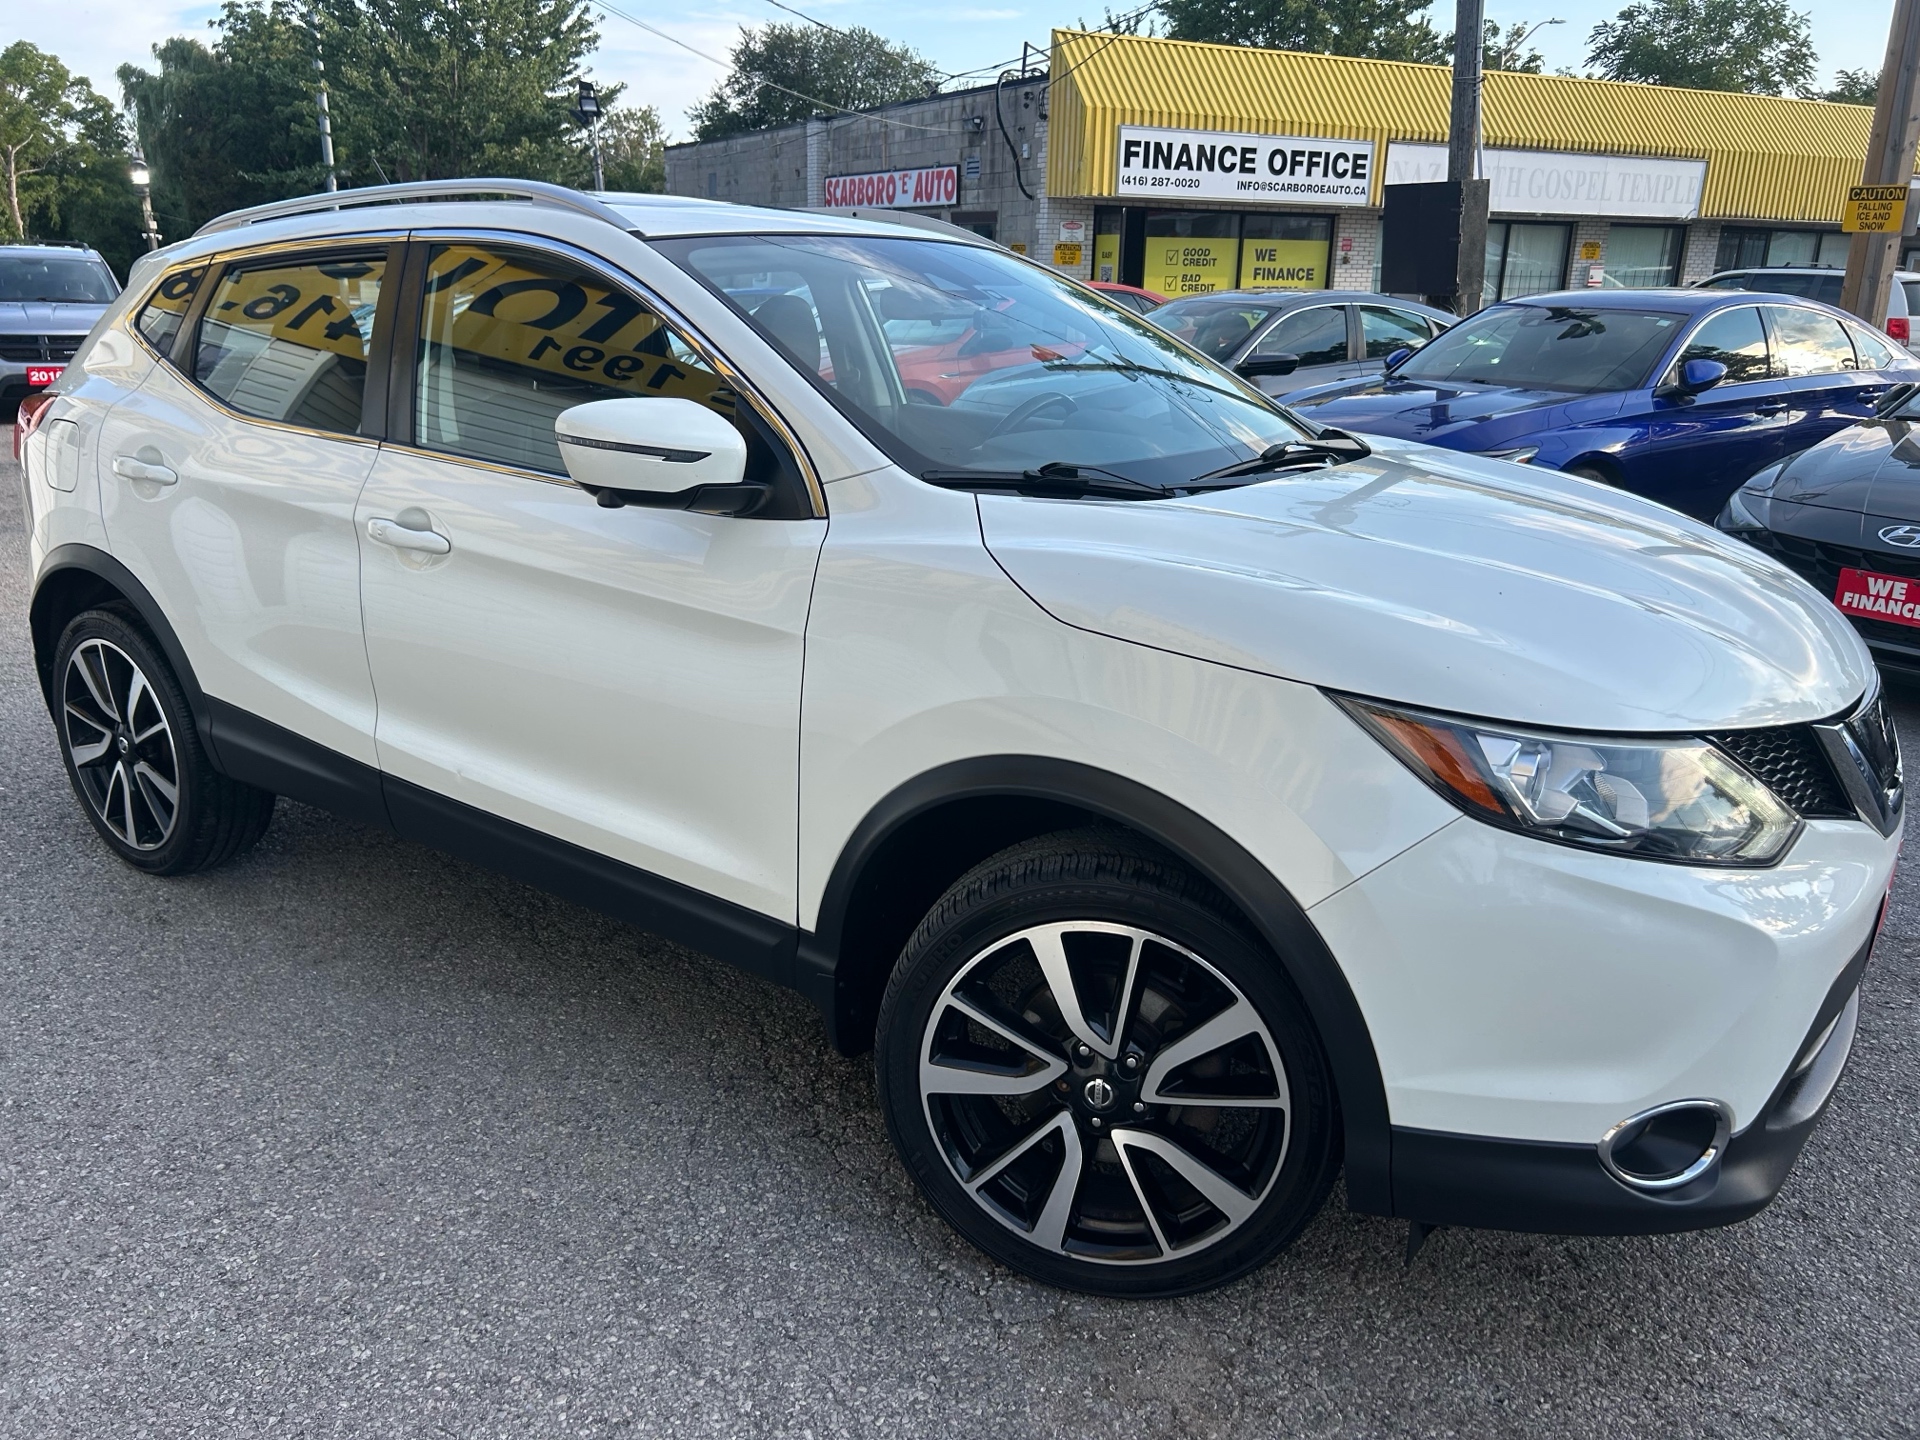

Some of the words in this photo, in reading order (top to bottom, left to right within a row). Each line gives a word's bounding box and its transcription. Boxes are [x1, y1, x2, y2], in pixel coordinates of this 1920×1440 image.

[1123, 139, 1257, 174] FINANCE
[1267, 148, 1369, 179] OFFICE
[825, 174, 897, 207] SCARBORO
[913, 168, 956, 203] AUTO
[1121, 174, 1148, 186] (416)
[1150, 176, 1200, 188] 287-0020
[1236, 180, 1366, 196] INFO@SCARBOROEAUTO.CA
[1528, 167, 1613, 201] GOSPEL
[1619, 172, 1699, 204] TEMPLE
[1851, 188, 1905, 200] CAUTION
[1857, 202, 1893, 211] FALLING
[1856, 211, 1871, 220] ICE
[1872, 212, 1891, 221] AND
[1858, 222, 1885, 231] SNOW
[1183, 248, 1211, 257] GOOD
[1254, 248, 1277, 262] WE
[1182, 258, 1217, 267] CREDIT
[1181, 274, 1202, 283] BAD
[1253, 267, 1315, 281] FINANCE
[1181, 283, 1215, 292] CREDIT
[1867, 577, 1908, 600] WE
[1842, 592, 1920, 620] FINANCE
